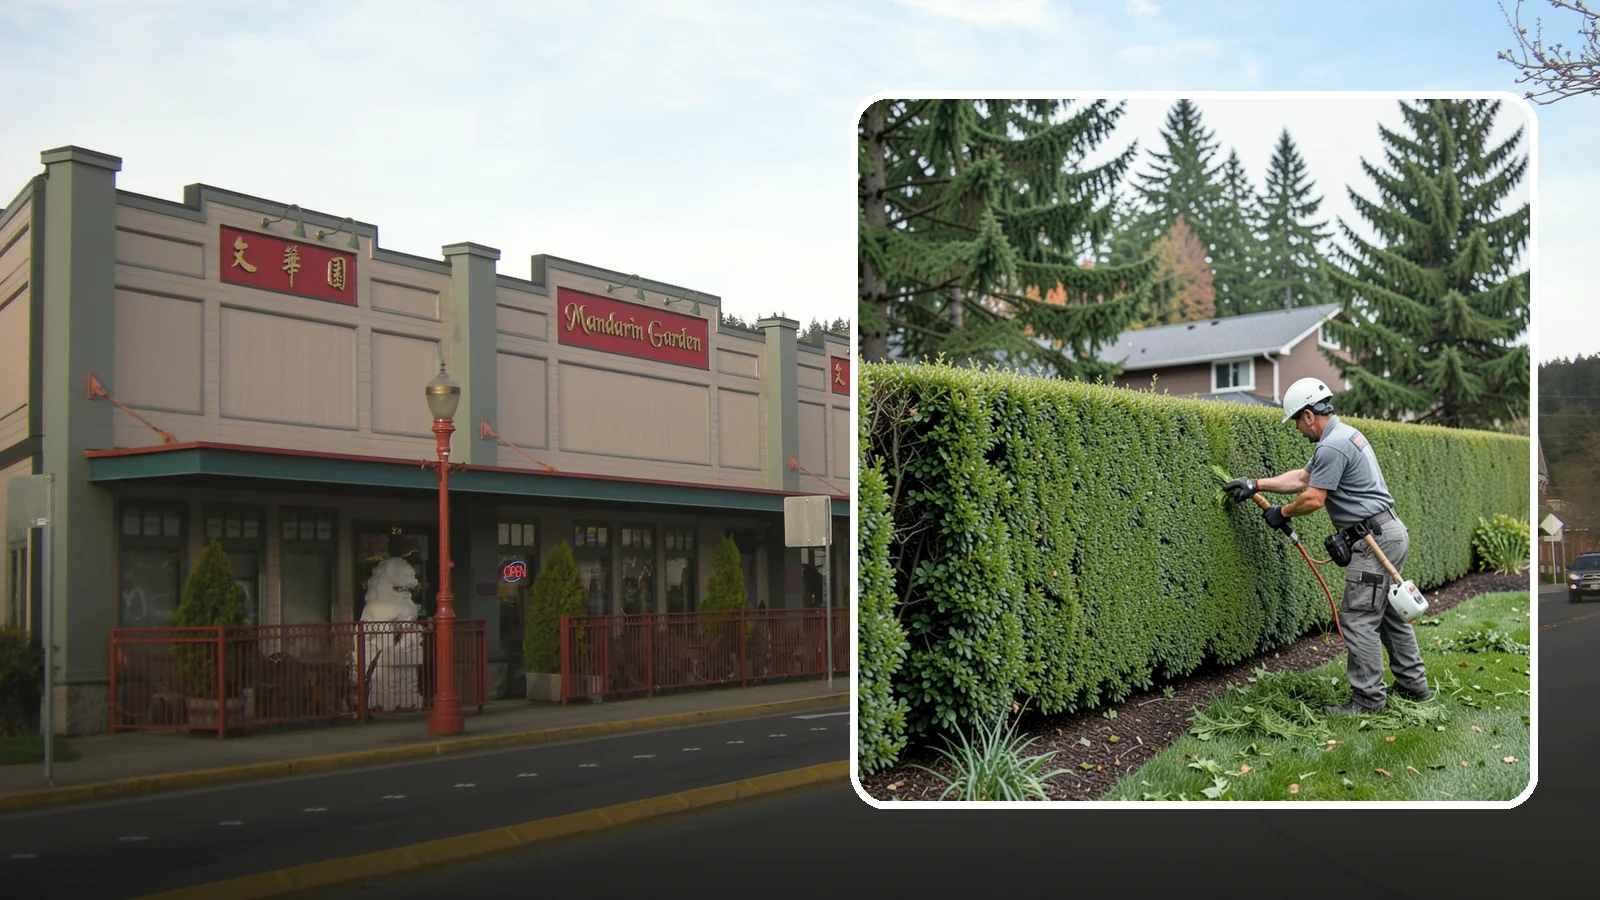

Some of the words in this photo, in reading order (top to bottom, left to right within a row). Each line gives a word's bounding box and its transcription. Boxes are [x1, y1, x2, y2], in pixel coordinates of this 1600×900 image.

[231, 236, 346, 291] 文華園
[564, 302, 644, 341] Mandarin
[648, 320, 701, 352] Garden
[503, 565, 526, 578] OPEN
